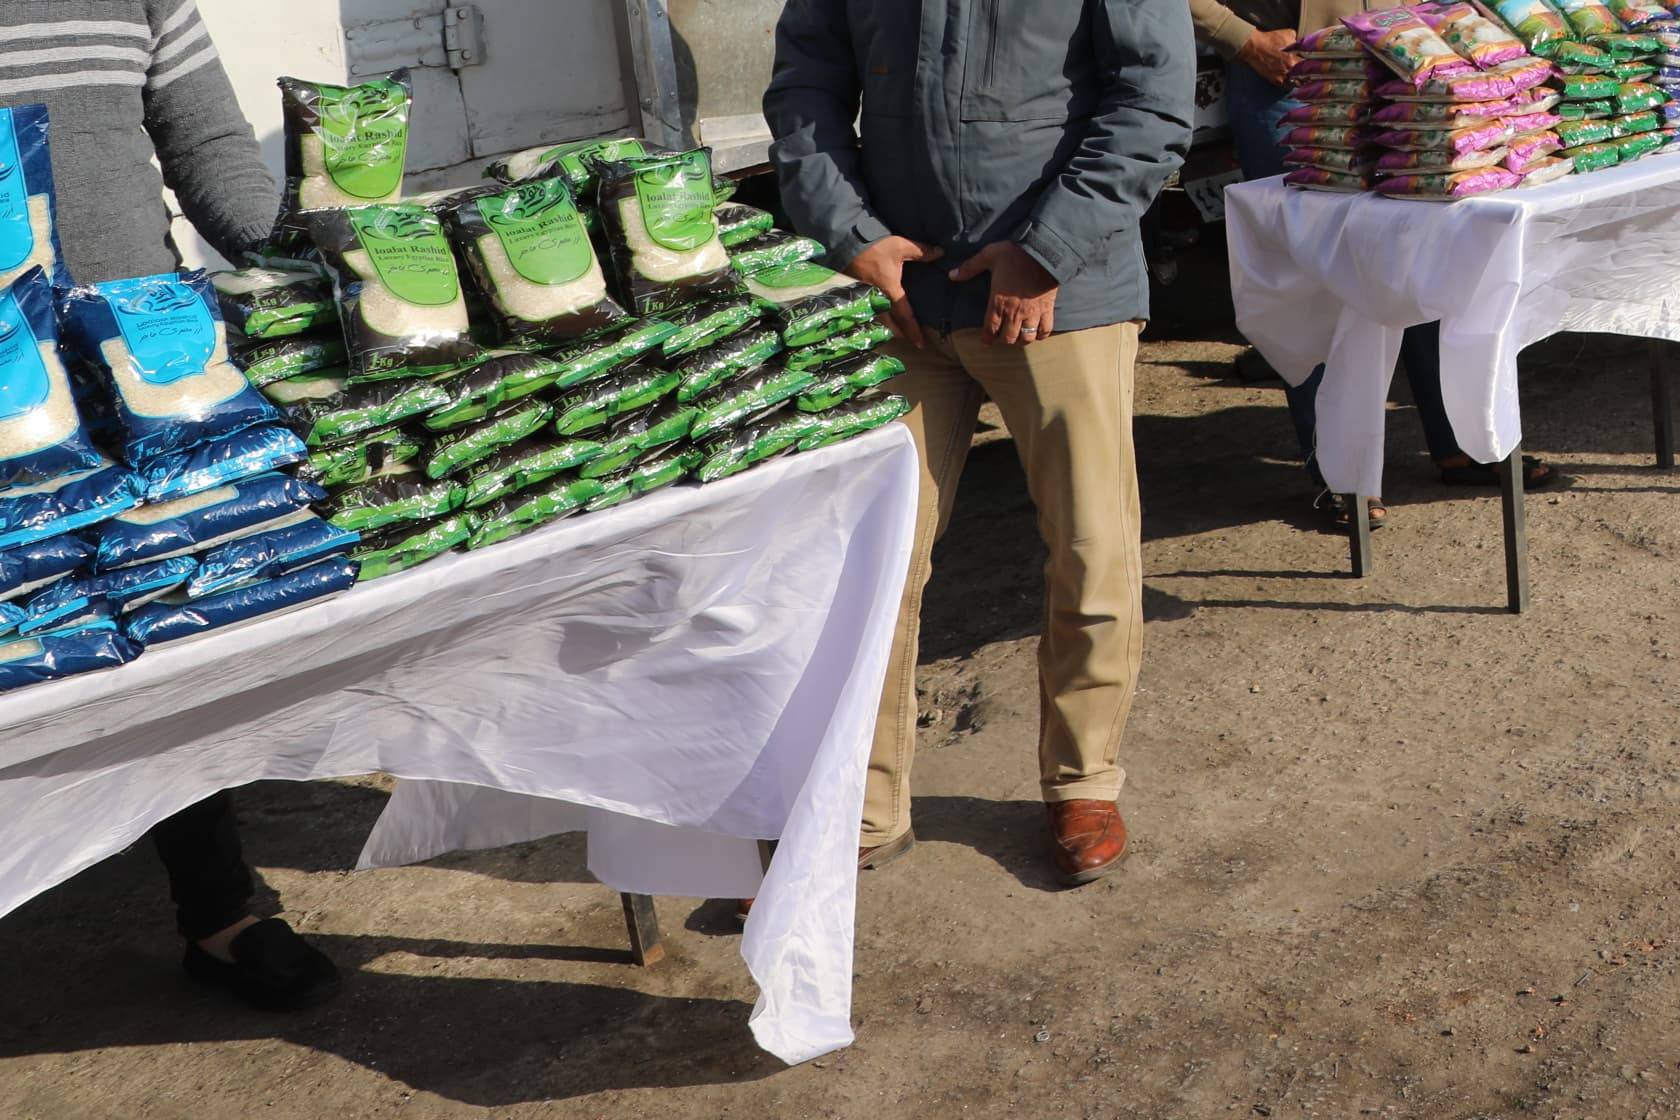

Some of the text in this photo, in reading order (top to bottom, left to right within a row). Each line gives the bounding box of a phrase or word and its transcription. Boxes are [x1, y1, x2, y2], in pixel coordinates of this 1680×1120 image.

[365, 129, 402, 140] Rashid
[538, 214, 574, 230] Rashid
[410, 244, 446, 255] Rashid
[380, 356, 394, 368] Kg
